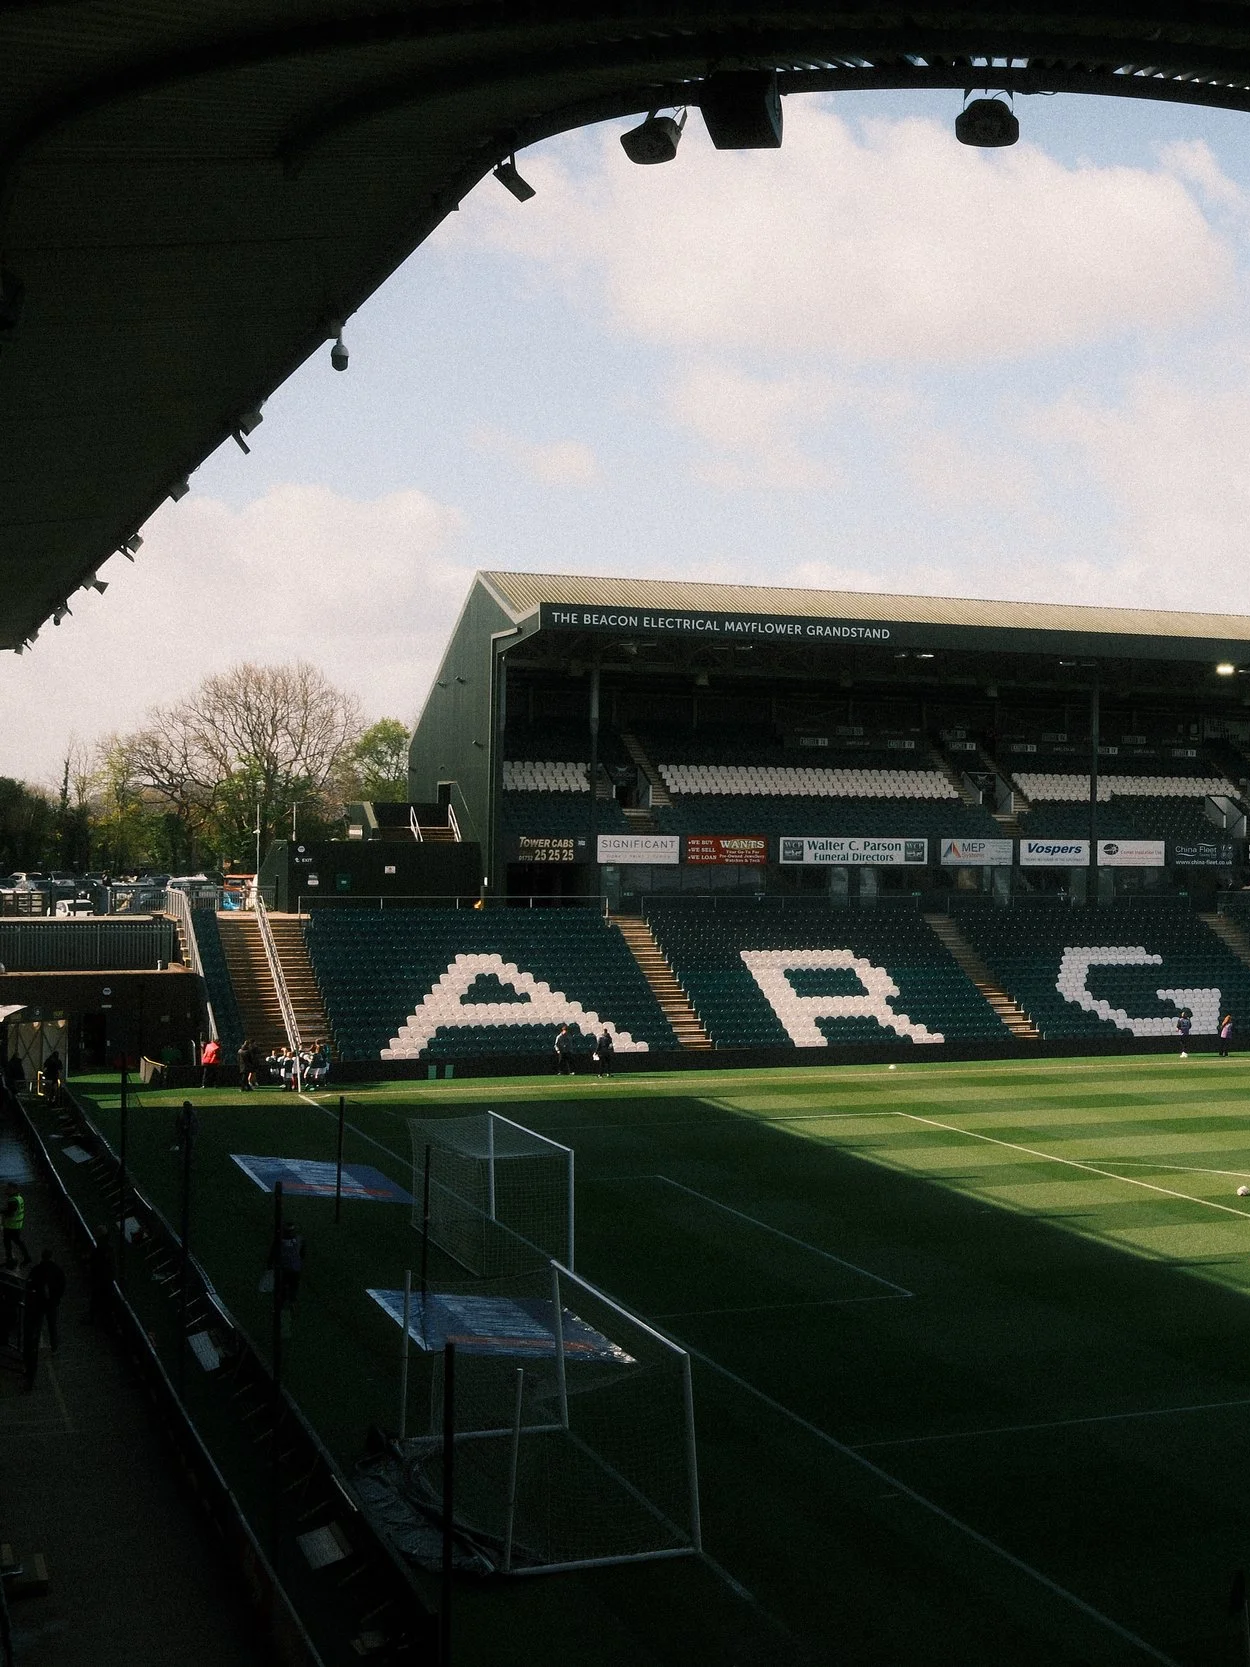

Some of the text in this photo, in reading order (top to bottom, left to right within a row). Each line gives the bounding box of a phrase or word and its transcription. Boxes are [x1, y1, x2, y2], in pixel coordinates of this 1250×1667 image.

[551, 612, 891, 639] THE BEACON ELECTRICAL MAYFLOWER GRANDSTAND
[519, 836, 574, 848] TOWER CABS
[601, 840, 675, 848] SIGNIFICANT
[720, 839, 765, 849] WANTS
[807, 840, 901, 851] Walter C. Parson
[962, 843, 986, 852] MEP
[1028, 843, 1082, 856] Vospers
[1175, 845, 1198, 853] China
[534, 849, 547, 861] 25
[548, 849, 560, 861] 25
[562, 849, 574, 861] 25
[814, 852, 894, 861] Funeral Directors
